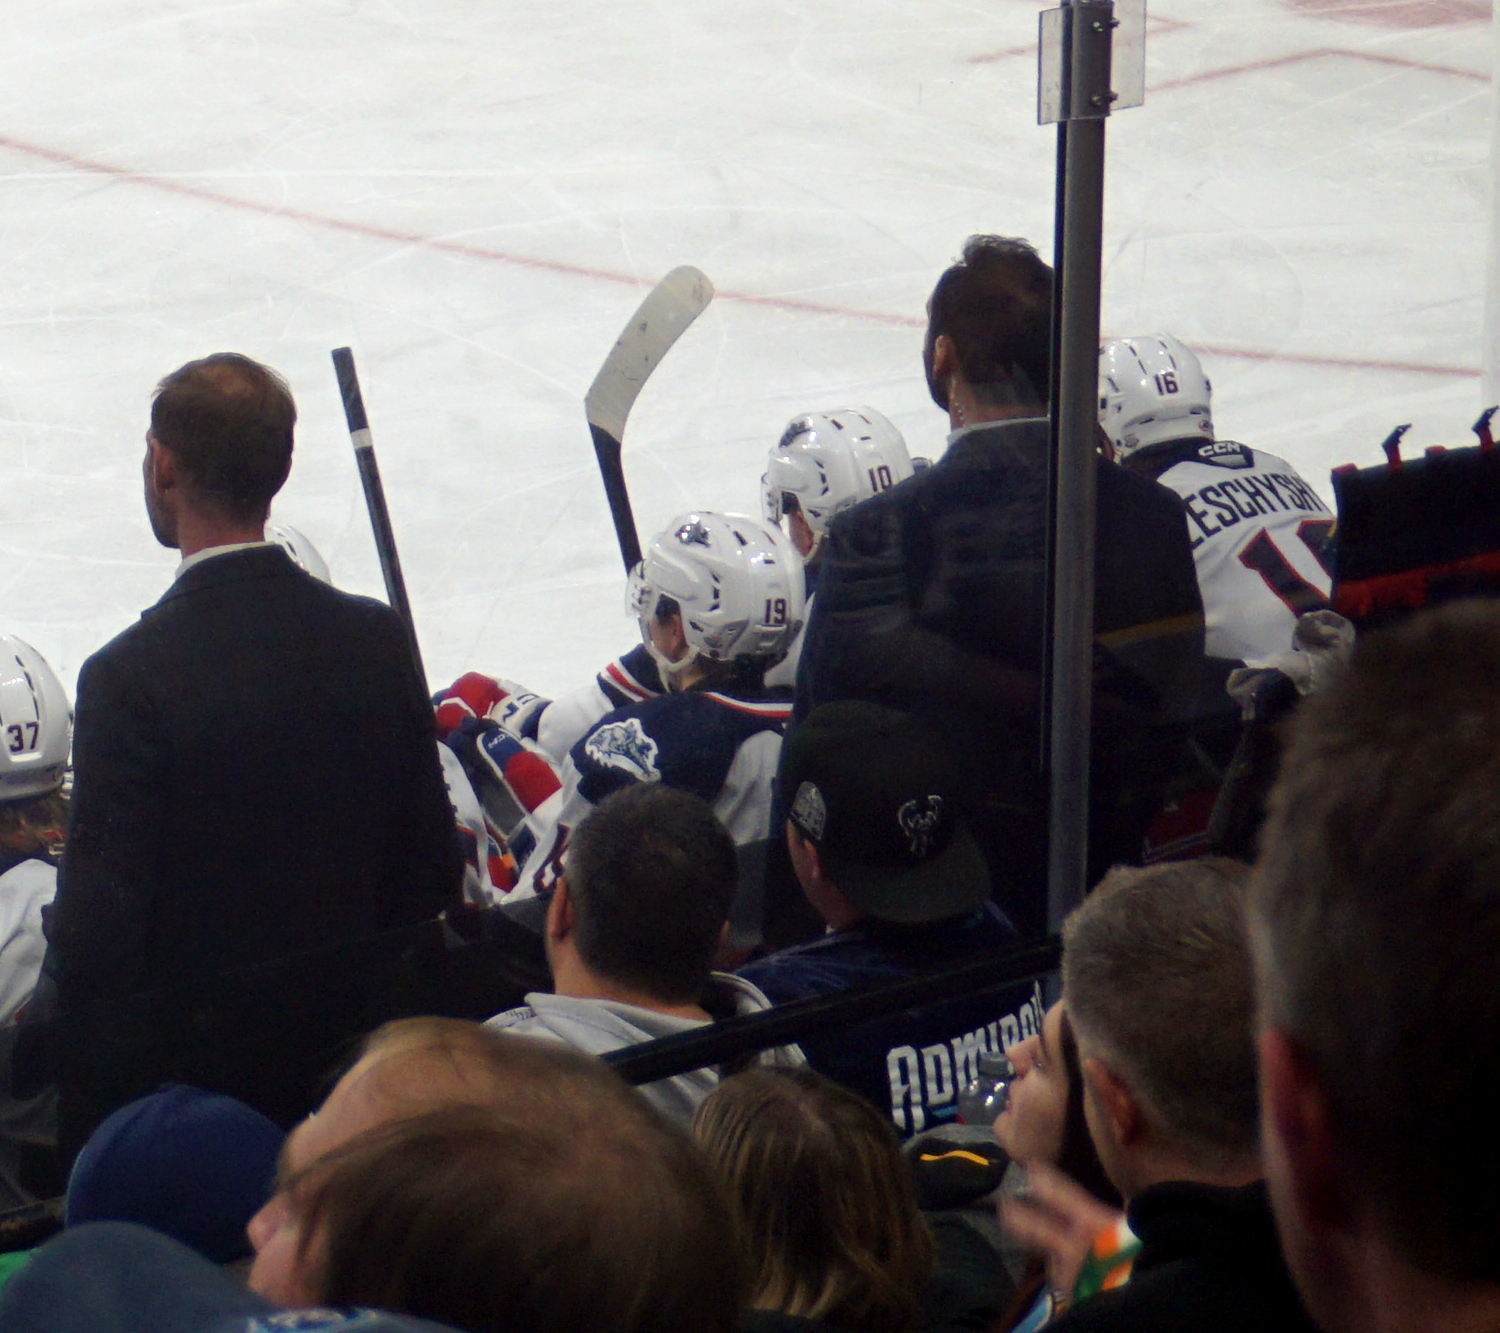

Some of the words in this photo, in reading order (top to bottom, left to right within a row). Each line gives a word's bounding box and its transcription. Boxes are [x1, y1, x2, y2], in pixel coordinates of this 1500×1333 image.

[1154, 371, 1179, 395] 16
[868, 465, 893, 492] 10
[763, 597, 787, 624] 19
[7, 722, 40, 752] 37
